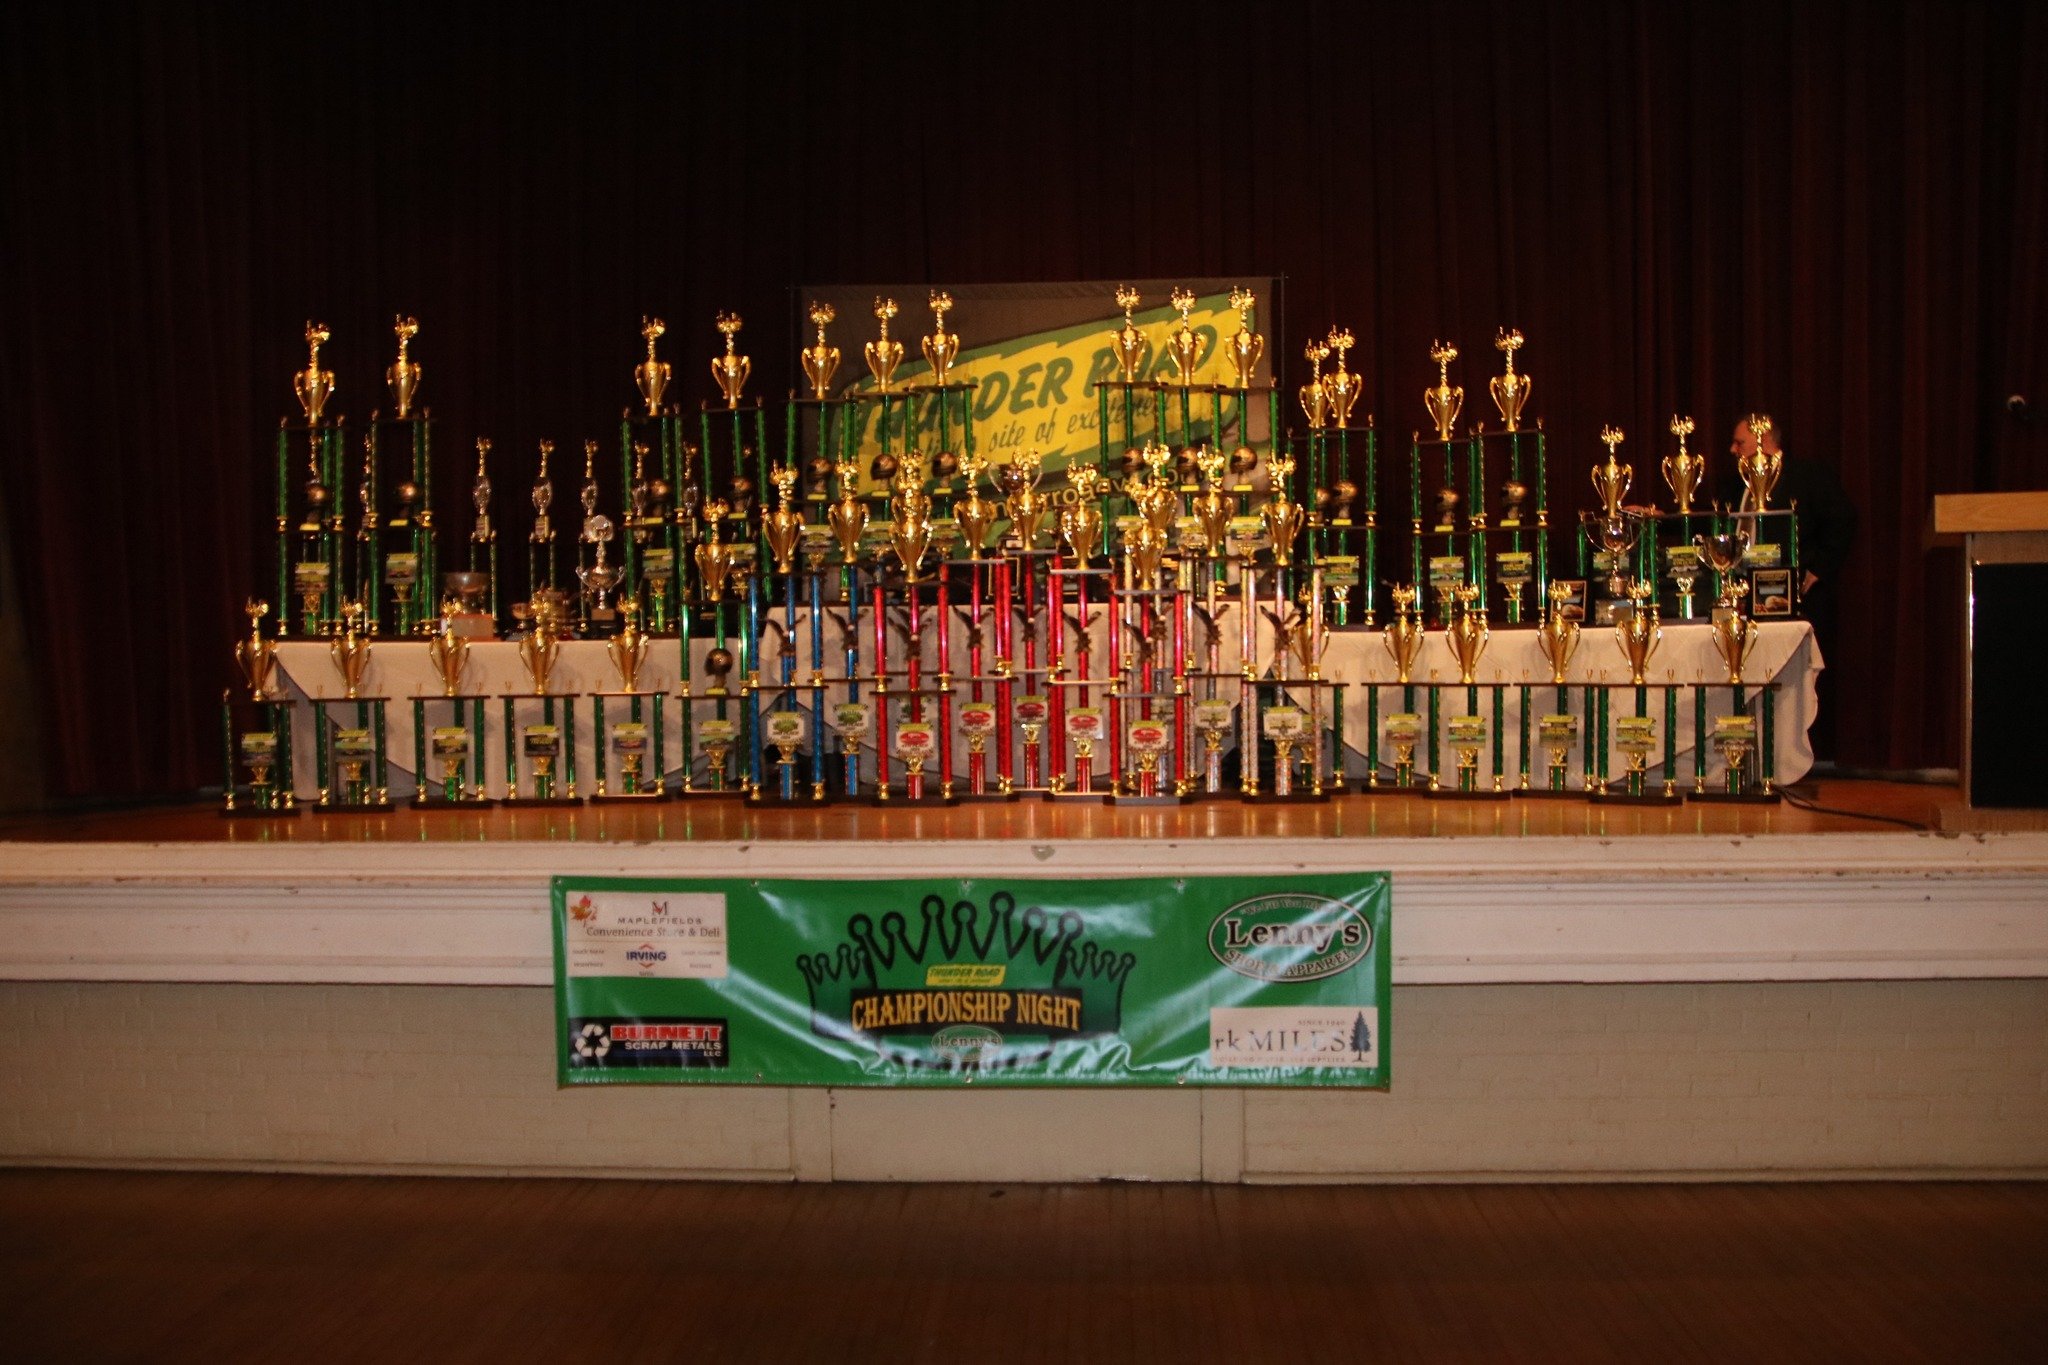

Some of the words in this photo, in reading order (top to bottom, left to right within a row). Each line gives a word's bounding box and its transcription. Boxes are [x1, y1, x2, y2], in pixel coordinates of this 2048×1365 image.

[988, 419, 1026, 452] site
[1035, 407, 1058, 445] of
[617, 917, 703, 925] MAPLEFIELDS
[586, 926, 657, 937] Convenience
[688, 927, 697, 937] &
[700, 926, 720, 938] Deli
[1225, 919, 1361, 953] Lenny's
[626, 950, 667, 961] IRVING
[1284, 948, 1355, 976] APPAREL
[852, 992, 1012, 1031] CHAMPIONSHIP
[1016, 993, 1081, 1031] NIGHT
[610, 1025, 722, 1041] BURNETT
[1215, 1029, 1241, 1051] rk
[1248, 1029, 1346, 1052] MILES
[625, 1042, 667, 1050] SCRAP
[672, 1042, 722, 1050] METALS
[938, 1034, 999, 1050] Lenny's
